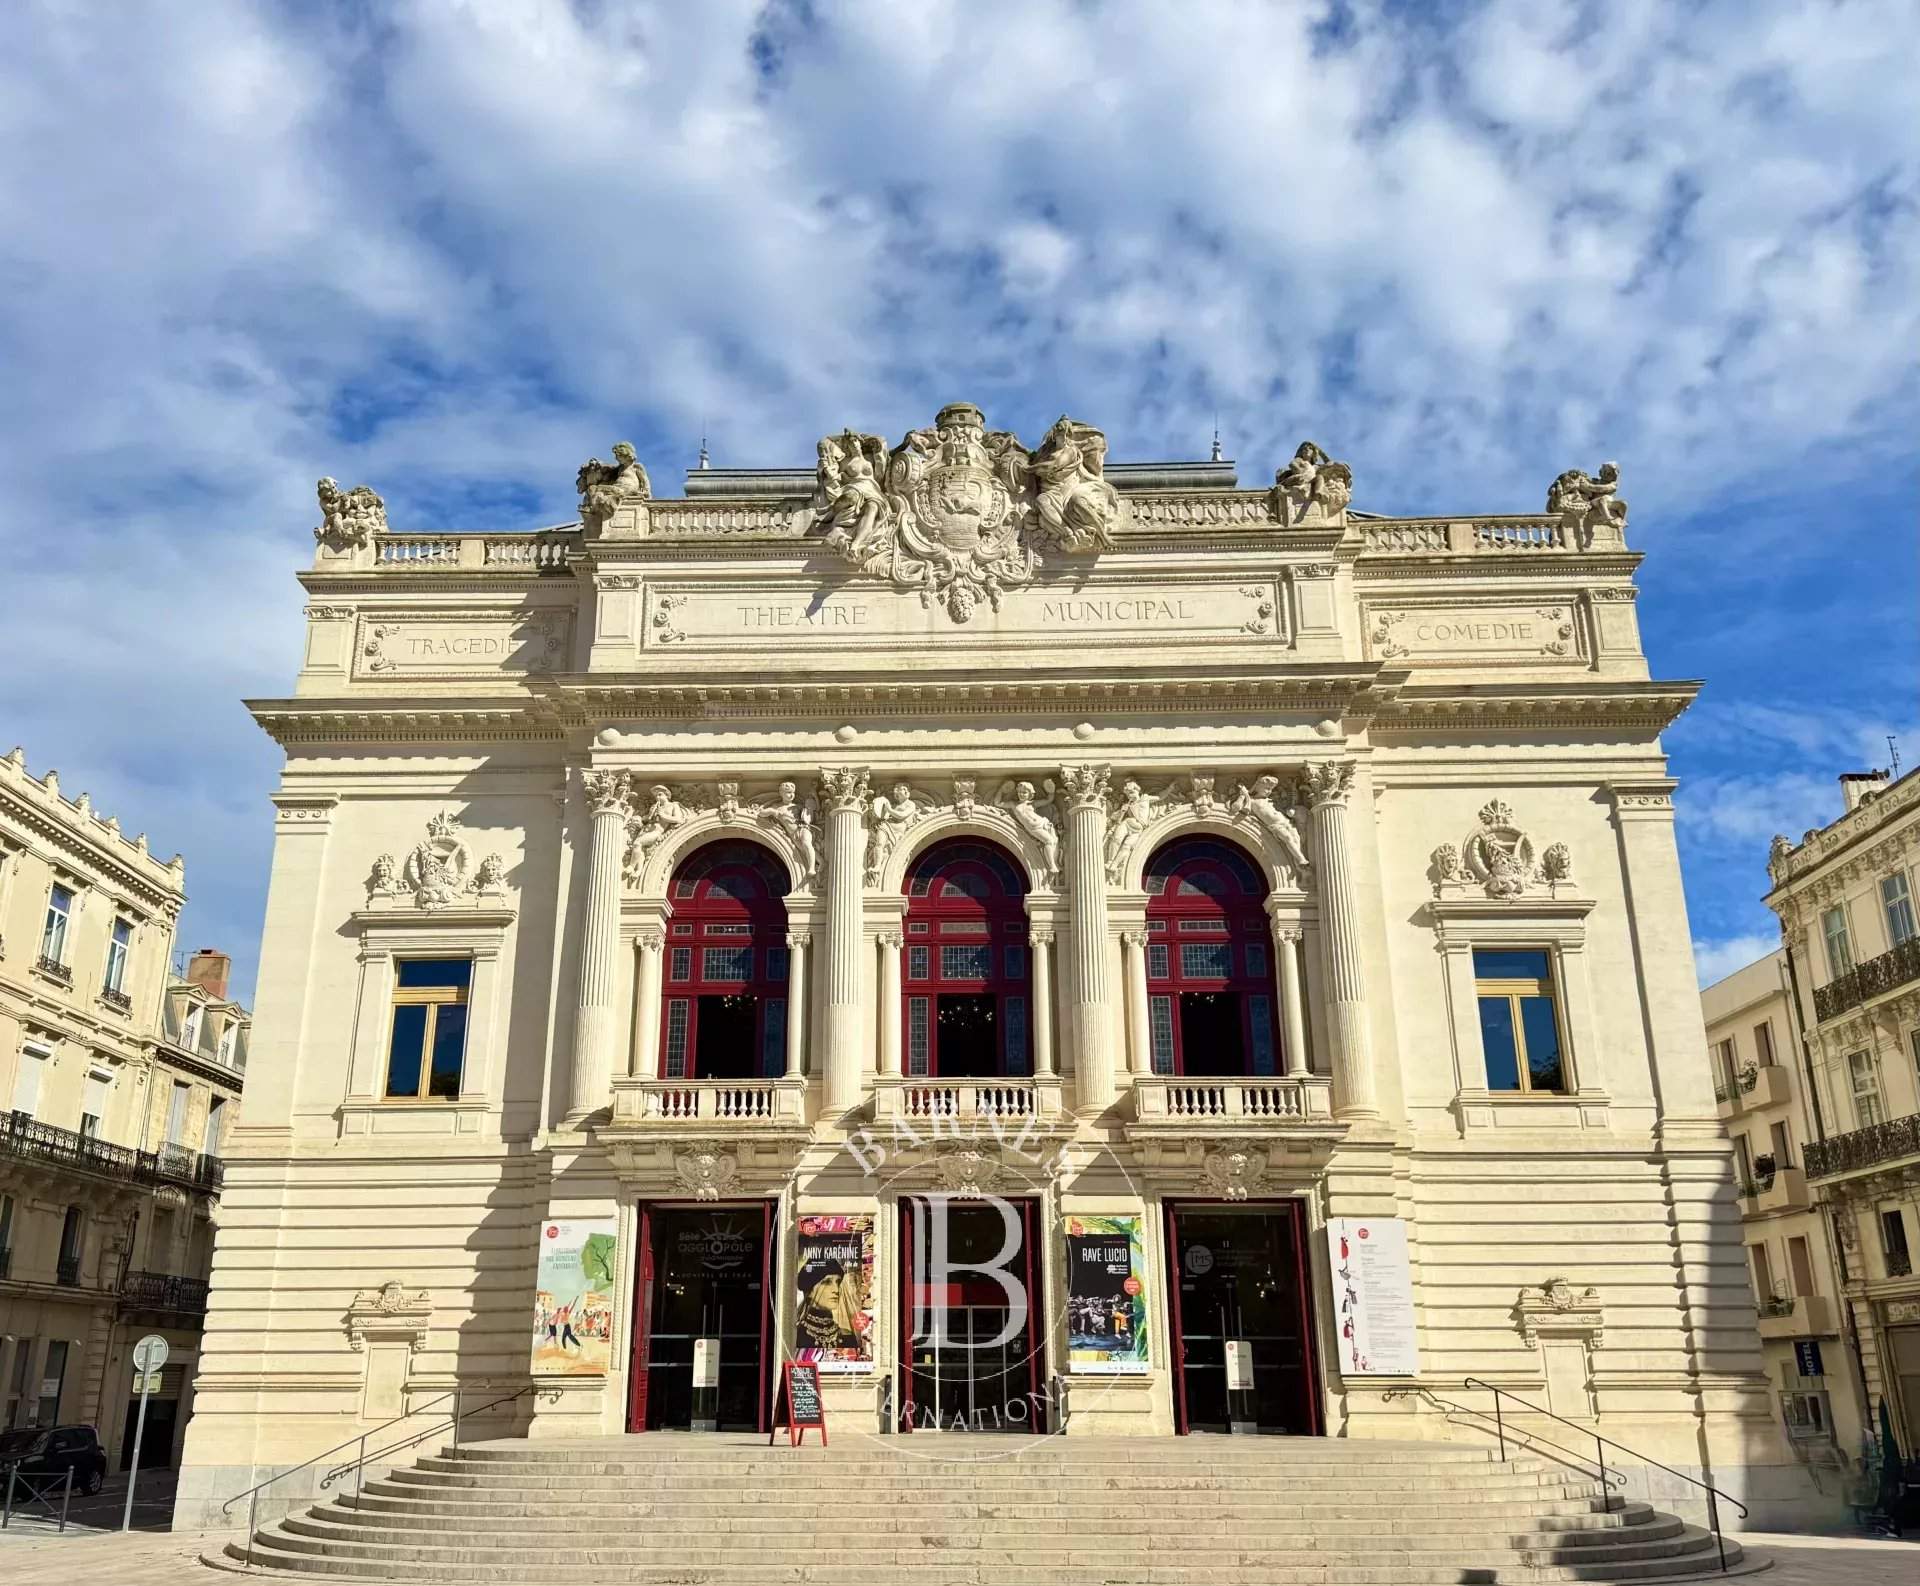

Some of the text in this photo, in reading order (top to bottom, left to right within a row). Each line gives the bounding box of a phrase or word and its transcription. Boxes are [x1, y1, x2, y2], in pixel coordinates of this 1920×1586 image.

[736, 600, 1195, 626] THEATRE MUNICIPAL
[1416, 623, 1533, 641] COMEDIE
[406, 637, 521, 655] TRAGEDIE
[1082, 1247, 1128, 1262] RAVE LUCID
